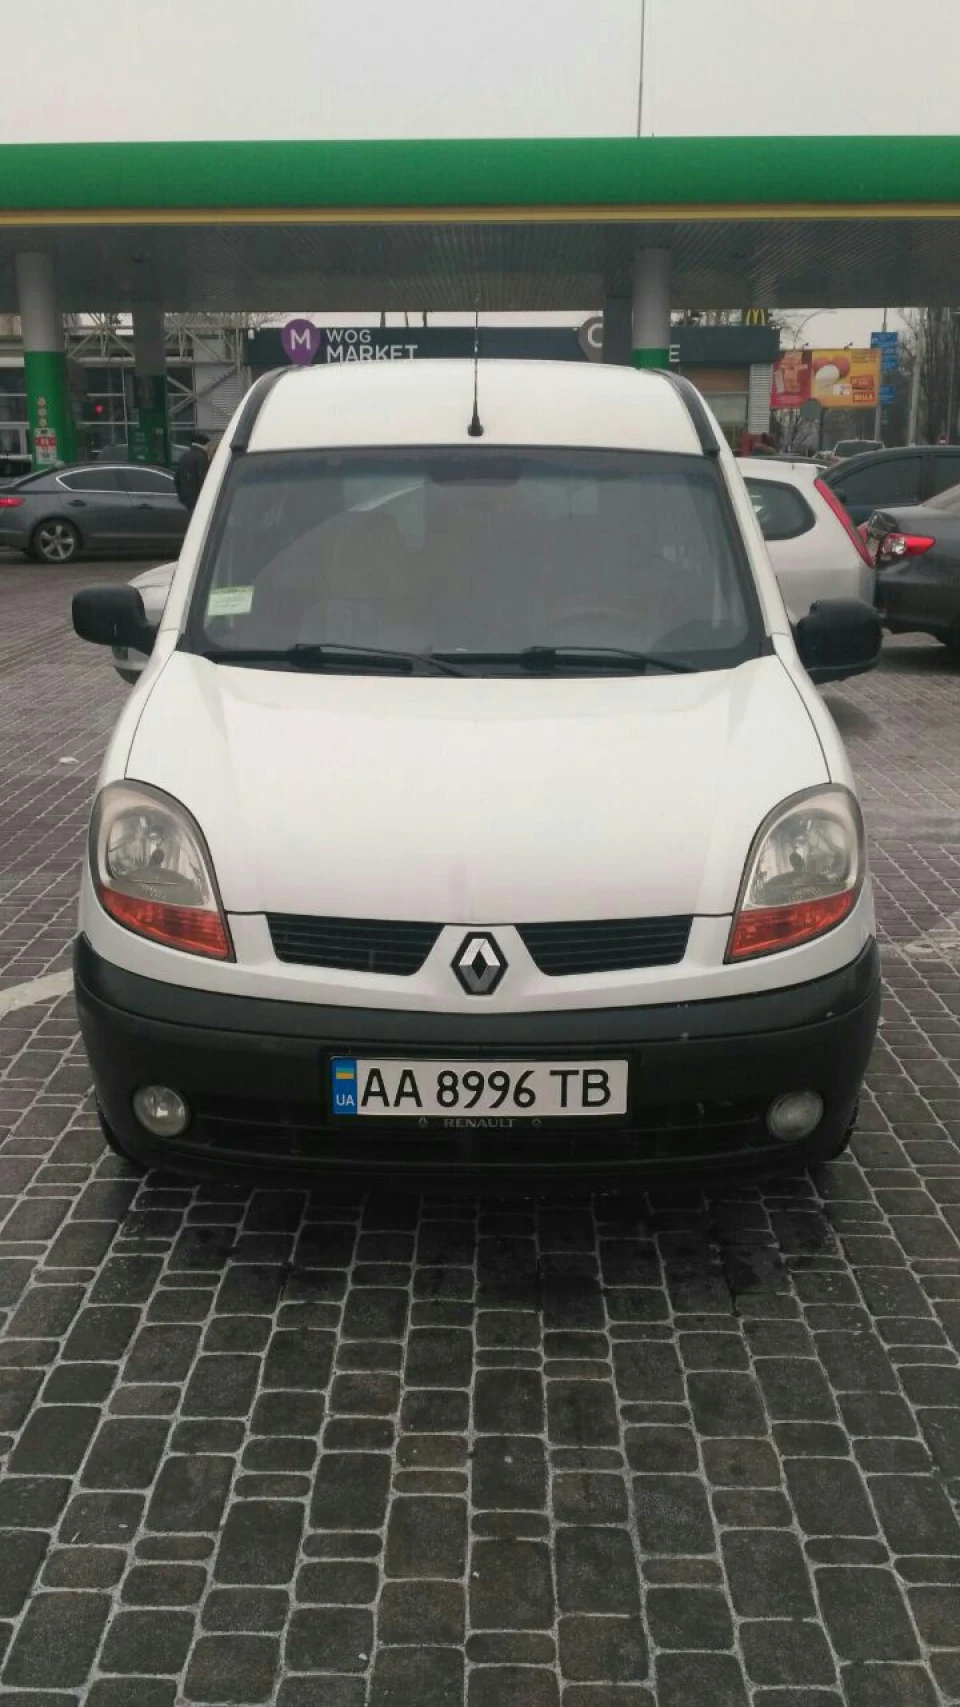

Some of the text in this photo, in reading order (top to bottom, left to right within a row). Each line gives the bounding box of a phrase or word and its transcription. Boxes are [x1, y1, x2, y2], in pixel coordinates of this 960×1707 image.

[290, 328, 312, 350] M
[326, 328, 372, 343] WOG
[327, 344, 419, 363] MARKET
[361, 1068, 612, 1108] AA 8996 TB
[336, 1094, 355, 1106] UA
[443, 1117, 517, 1128] RENAULT
